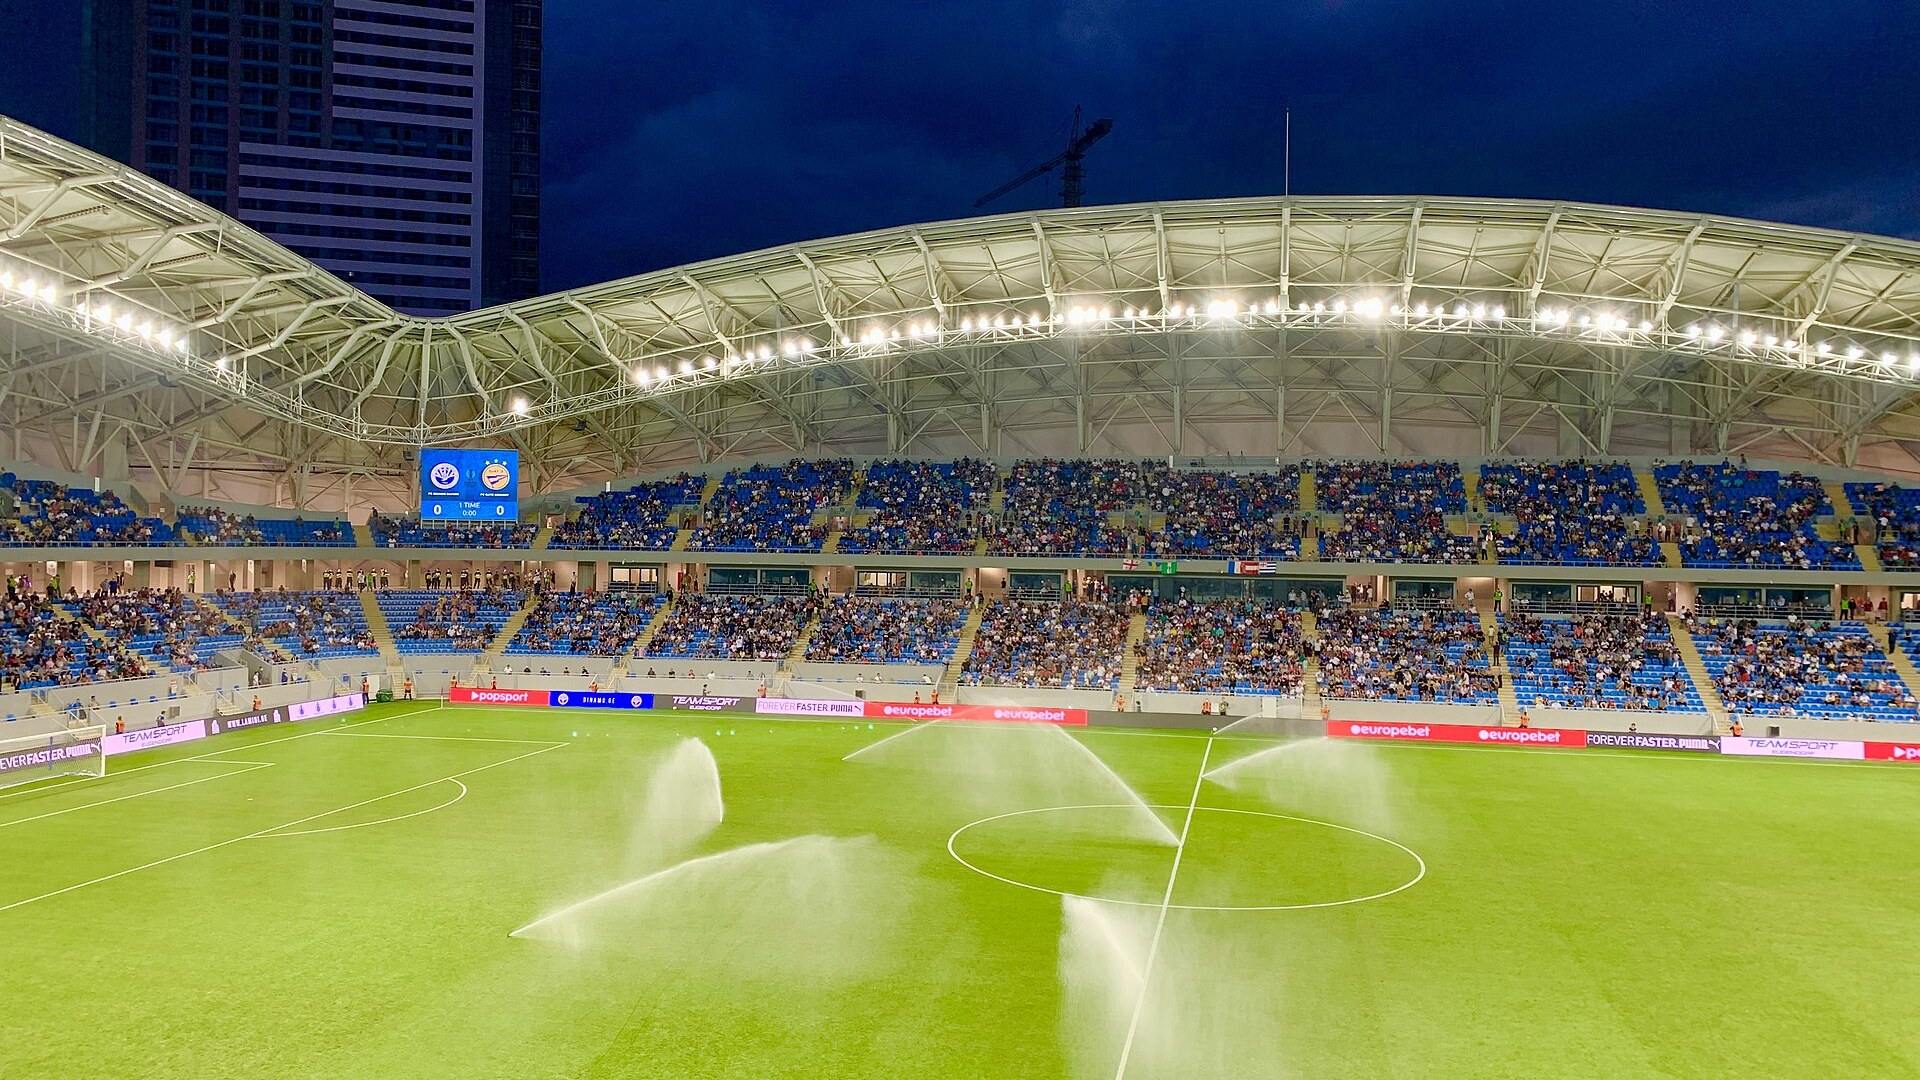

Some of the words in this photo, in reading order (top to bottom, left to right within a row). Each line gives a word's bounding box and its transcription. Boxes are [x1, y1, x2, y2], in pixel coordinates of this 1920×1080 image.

[433, 504, 442, 515] 0
[496, 505, 505, 516] 0
[479, 692, 529, 703] popsport
[582, 696, 616, 704] DINAMO.GE
[672, 696, 741, 706] TEAMSPORT
[757, 701, 796, 710] FOREVER
[830, 704, 853, 713] PUMA
[892, 705, 953, 717] europebet
[1003, 709, 1065, 722] europebet
[122, 725, 188, 743] TEAMSPORT
[1361, 725, 1430, 737] europebet
[1488, 730, 1561, 743] europebet
[1587, 734, 1635, 746] FOREVER
[1747, 739, 1839, 750] TEAMSPORT
